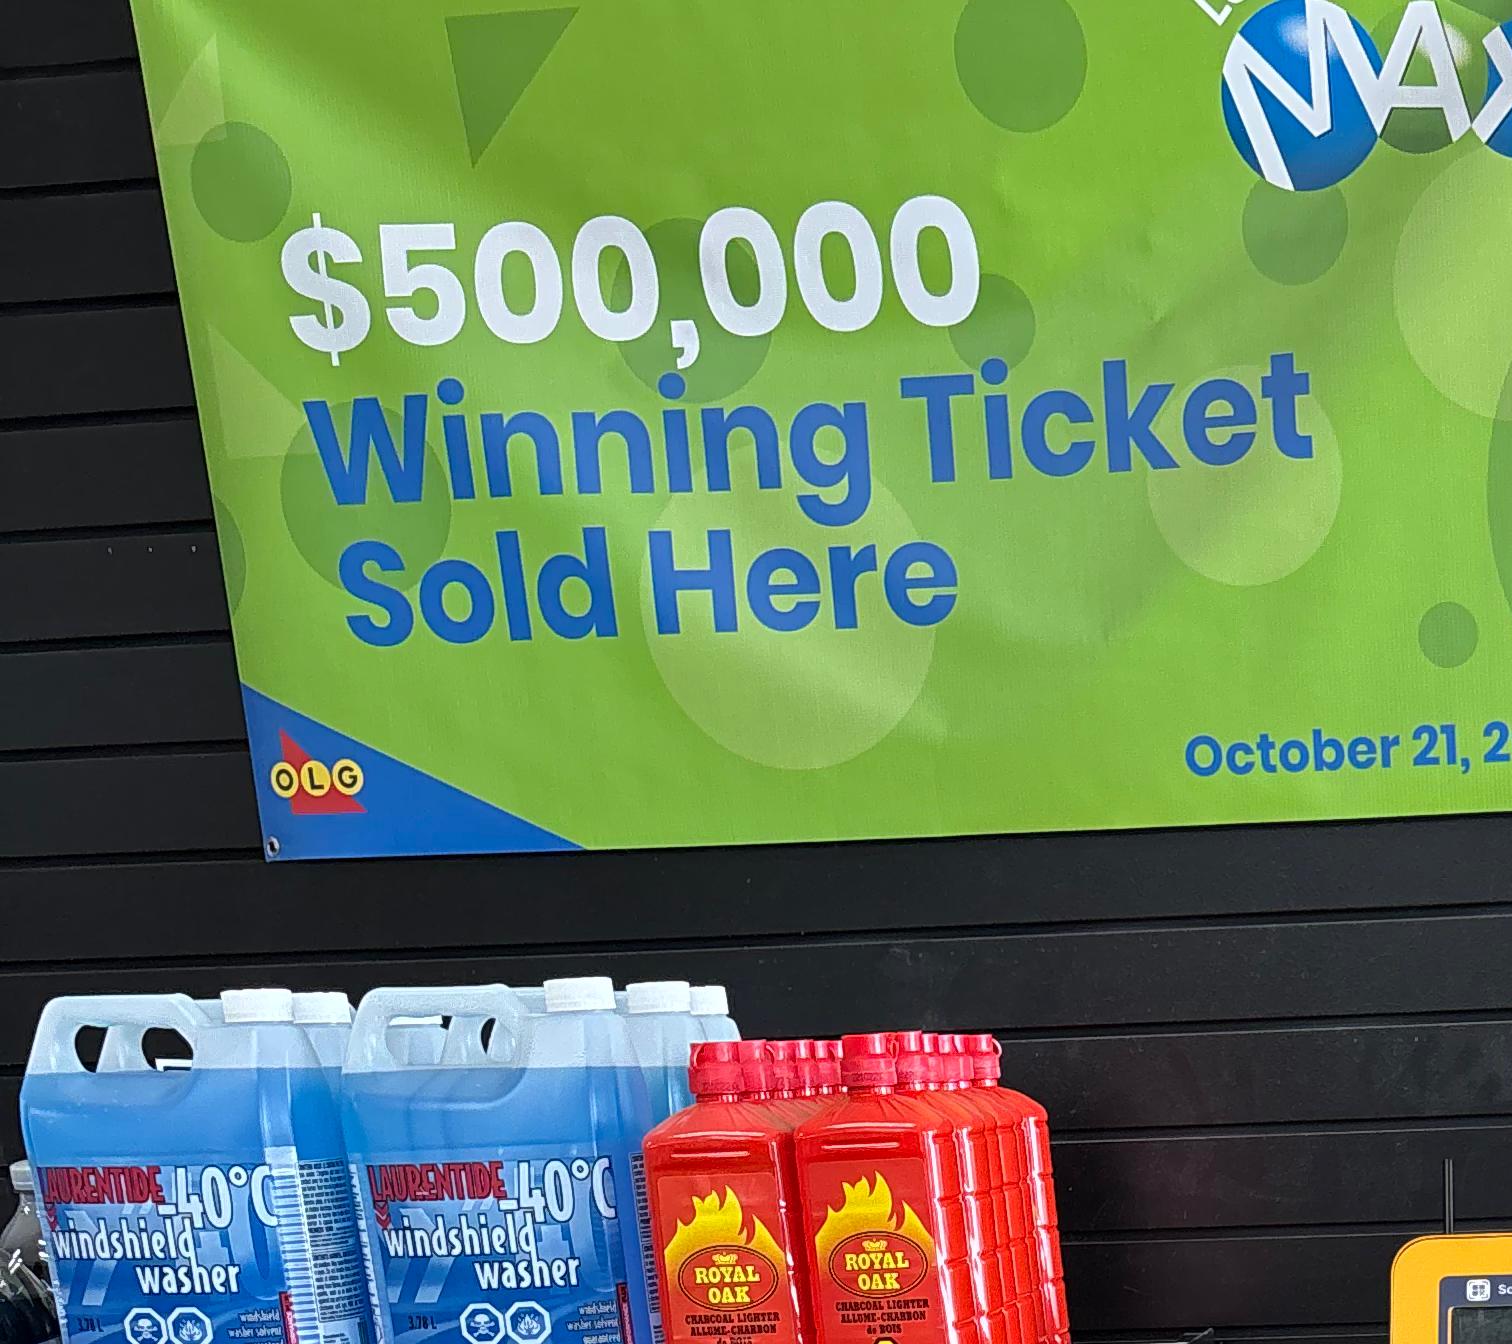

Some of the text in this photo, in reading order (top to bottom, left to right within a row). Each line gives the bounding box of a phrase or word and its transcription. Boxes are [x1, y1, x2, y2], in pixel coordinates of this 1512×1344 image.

[281, 195, 979, 368] $500,000
[304, 353, 1313, 526] Winning Ticket
[339, 527, 958, 647] Sold Here
[1185, 731, 1399, 776] October
[1412, 724, 1471, 773] 21,
[272, 759, 364, 797] OLG
[368, 1161, 507, 1202] LAURENTIDE
[52, 1218, 196, 1260] windshield
[384, 1213, 536, 1257] windshield
[135, 1264, 240, 1294] washer
[474, 1258, 579, 1290] washer
[694, 1266, 760, 1284] ROYAL
[845, 1252, 909, 1271] ROYAL
[708, 1286, 750, 1303] OAK
[858, 1272, 900, 1290] OAK
[685, 1312, 780, 1325] CHARCOAL LIGHTER
[836, 1299, 929, 1311] CHARCOAL LIGHTER
